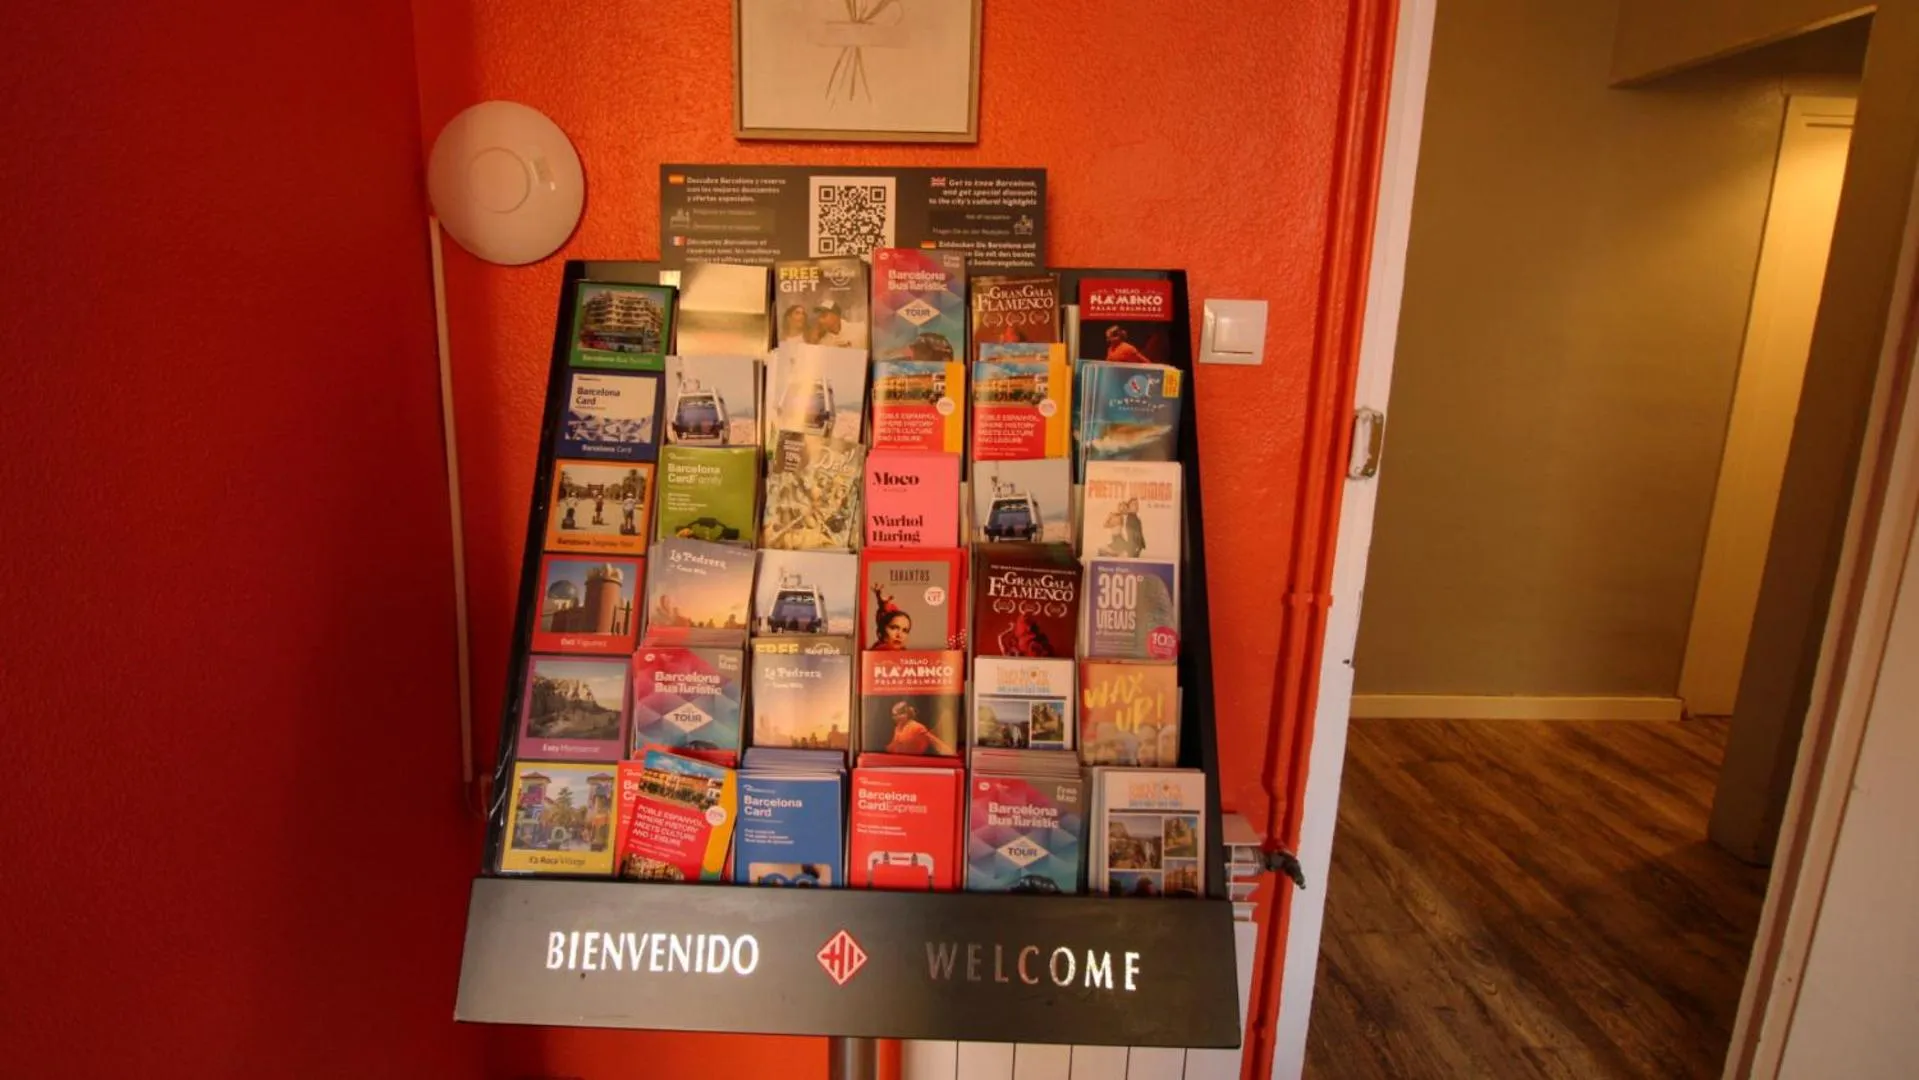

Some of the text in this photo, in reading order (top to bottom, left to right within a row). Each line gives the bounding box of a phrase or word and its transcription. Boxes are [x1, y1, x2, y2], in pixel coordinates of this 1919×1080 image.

[949, 179, 963, 187] Get
[974, 179, 994, 187] know
[780, 267, 820, 281] FREE
[888, 269, 946, 281] Barcelona
[780, 280, 819, 293] GIFT
[976, 293, 1054, 312] FLAMENCO
[1090, 295, 1163, 306] FLAMENCO
[905, 308, 930, 317] TOUR
[577, 386, 621, 397] Barcelona
[576, 396, 596, 405] Card
[581, 444, 616, 453] Barcelona
[668, 463, 721, 475] Barcelona
[873, 471, 920, 487] Moco
[1088, 479, 1173, 500] PRETTY WOMAN
[872, 514, 924, 528] Warhol
[872, 529, 921, 545] Haring
[682, 551, 728, 571] Pedrera
[889, 568, 931, 582] TARANTOS
[987, 575, 1074, 602] FLAMENCO
[1096, 608, 1137, 632] VIEWS
[654, 671, 721, 685] Barcelona
[777, 667, 823, 680] Pedrera
[873, 665, 954, 678] FLAMENCO
[1084, 673, 1144, 709] WAX
[673, 712, 702, 723] TOUR
[1114, 692, 1165, 735] UP!
[542, 743, 560, 754] Easy
[858, 788, 917, 803] Barcelona
[1056, 785, 1078, 795] Free
[744, 795, 803, 808] Barcelona
[1056, 793, 1078, 802] Map
[744, 806, 773, 818] Card
[857, 800, 928, 815] CardExpress
[988, 801, 1059, 818] Barcelona
[664, 818, 700, 834] HISTORY
[633, 828, 681, 847] AND LEISURE
[1007, 847, 1039, 858] TOUR
[545, 930, 760, 976] BIENVENIDO
[925, 940, 1142, 992] WELCOME
